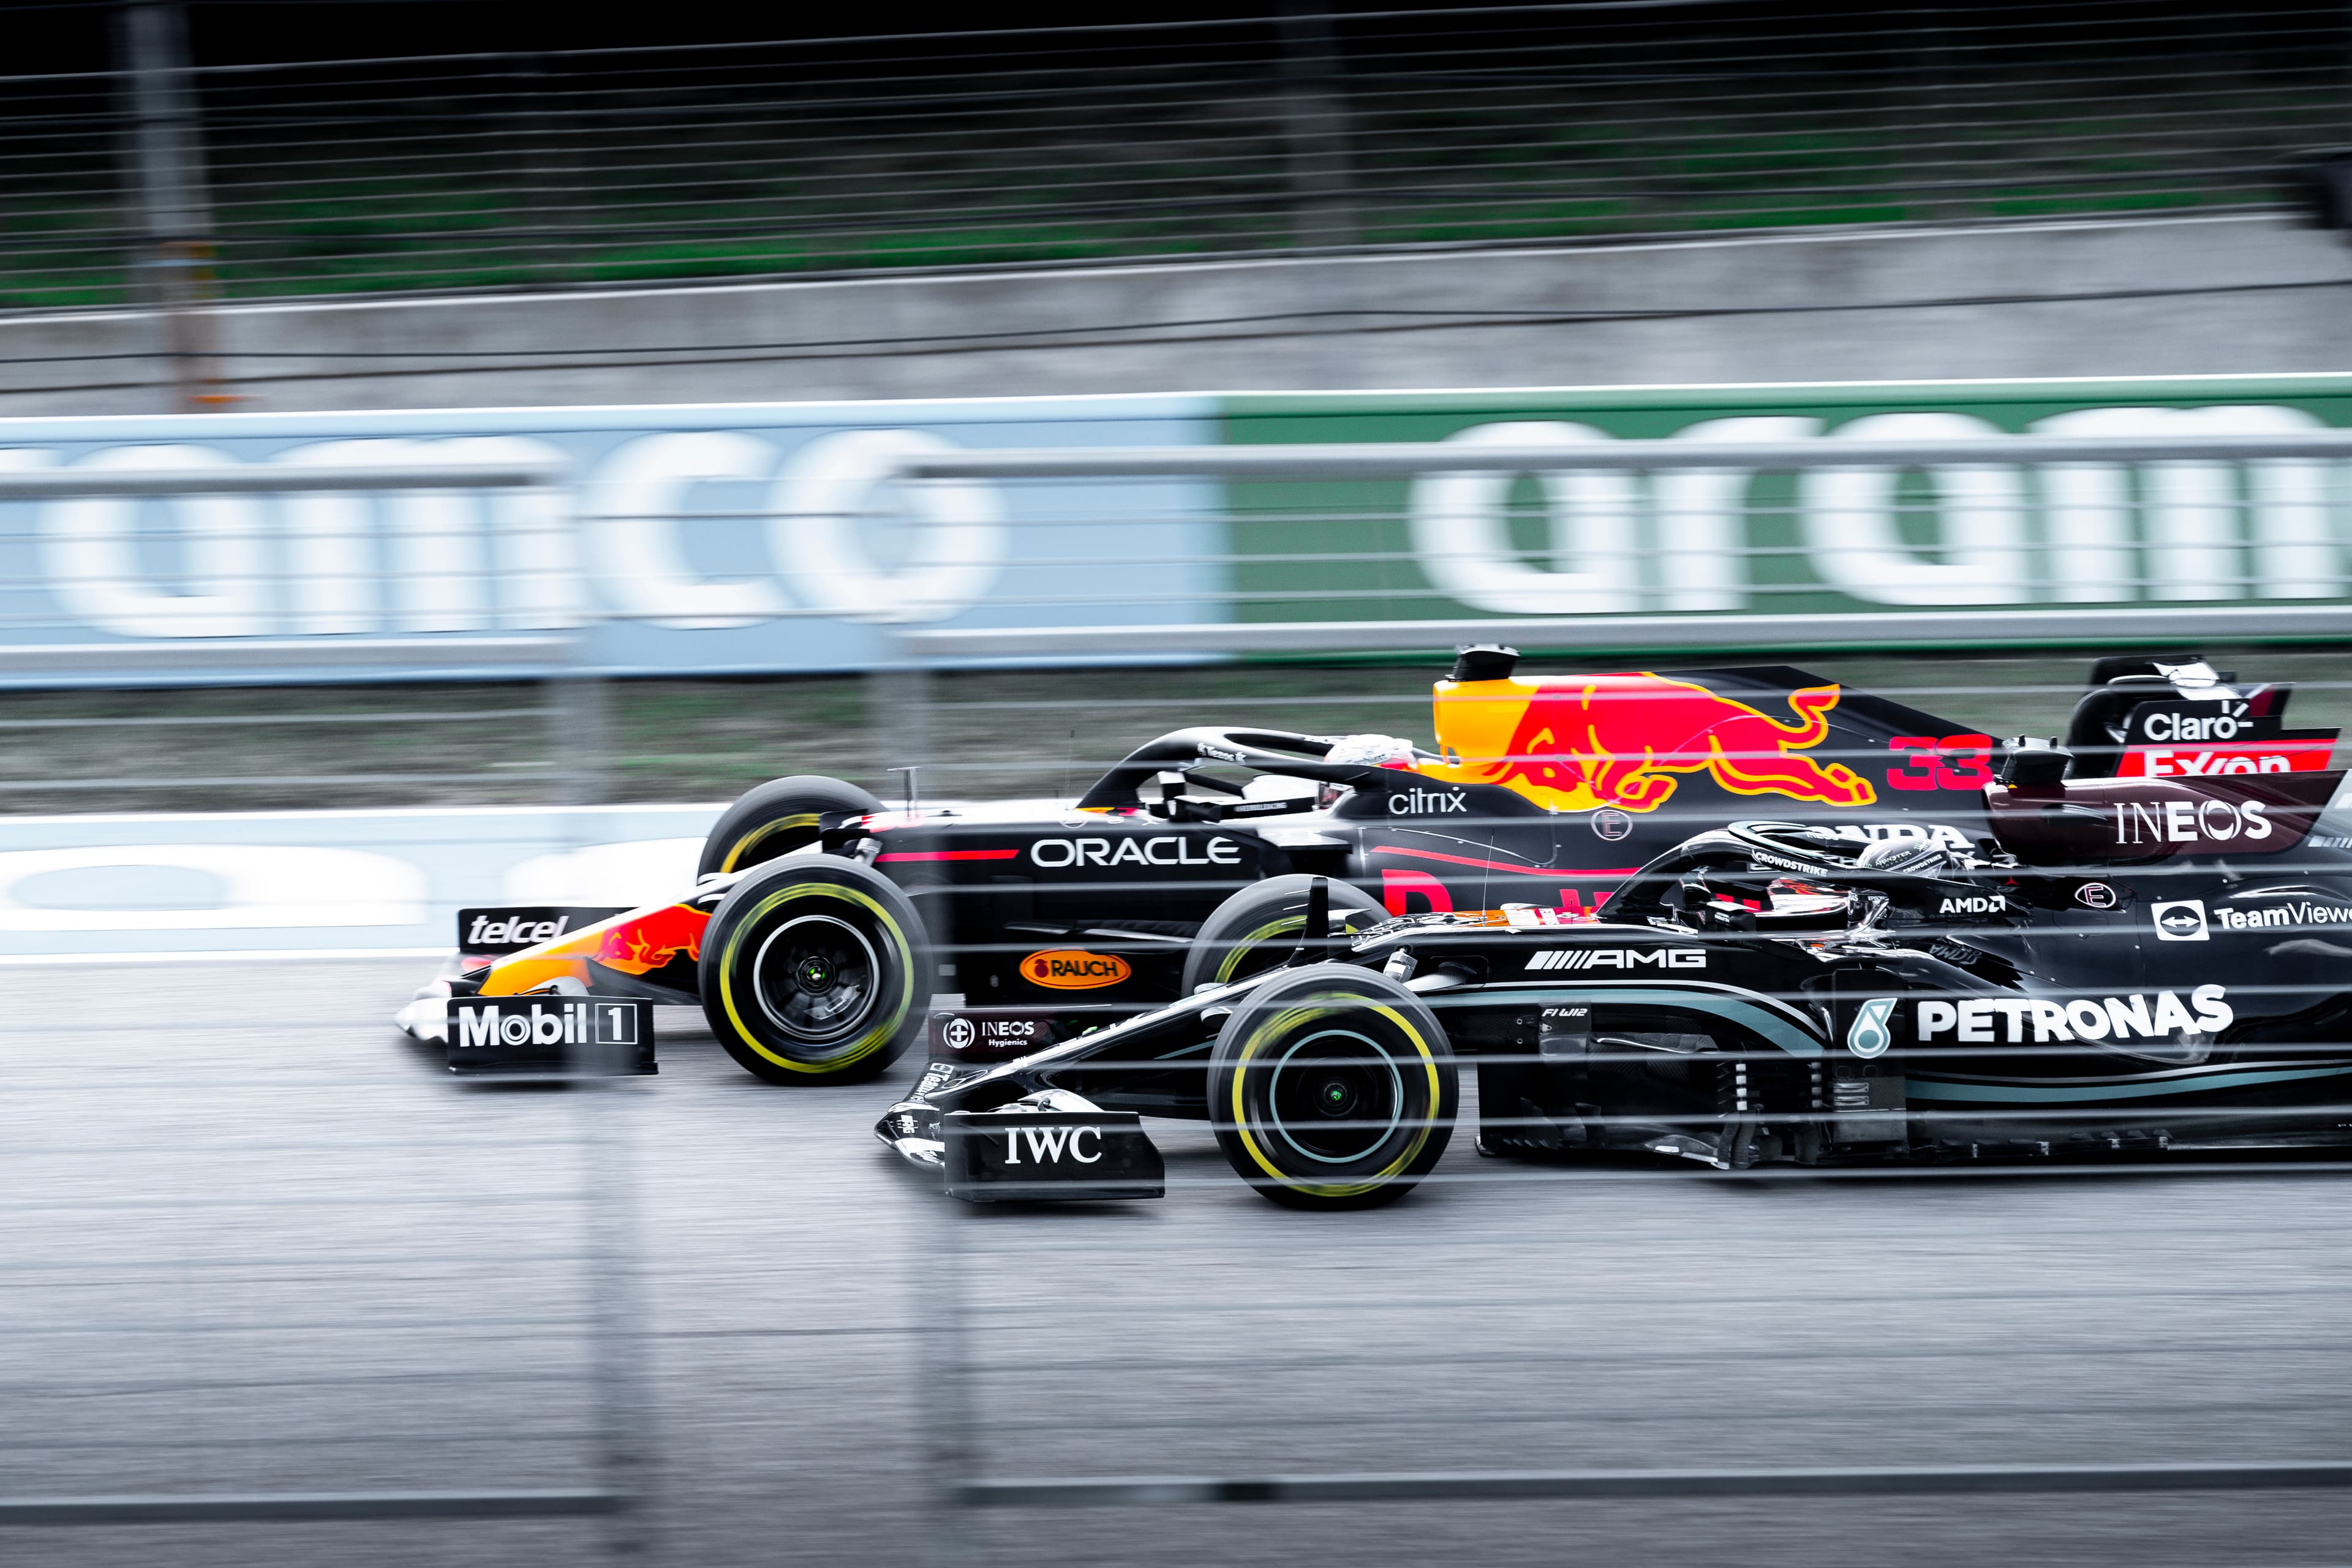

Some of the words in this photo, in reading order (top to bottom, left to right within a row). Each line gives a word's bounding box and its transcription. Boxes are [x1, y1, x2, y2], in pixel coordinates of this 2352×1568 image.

[2144, 712, 2237, 740] Claro
[1887, 734, 1992, 790] 33
[1389, 786, 1467, 814] citrix
[2114, 800, 2272, 843] INEOS
[1031, 837, 1242, 867] ORACLE
[1755, 851, 1828, 877] CROWDSTRIKE
[1939, 897, 1989, 914] AMD
[469, 915, 568, 944] telcel
[1051, 960, 1118, 977] RAUCH
[1586, 949, 1706, 969] AMG
[459, 1003, 587, 1047] Mobil
[1918, 984, 2234, 1042] PETRONAS
[981, 1020, 1034, 1036] INEOS
[988, 1038, 1028, 1048] Hygienics
[1005, 1126, 1102, 1164] IWC
